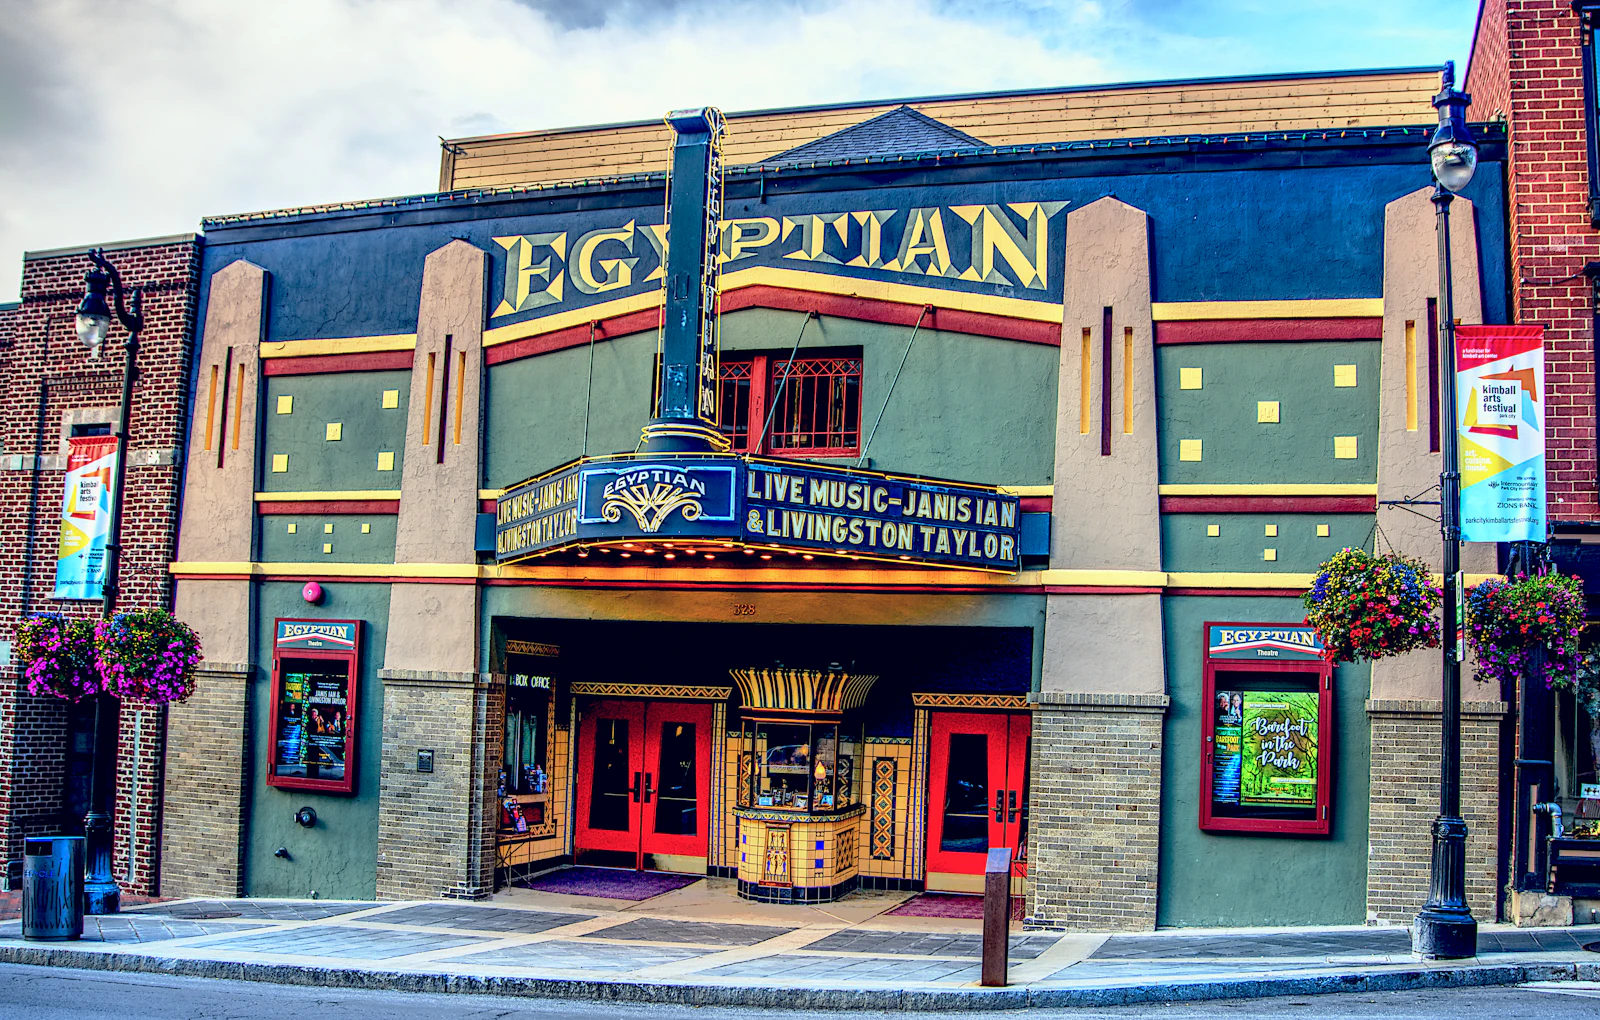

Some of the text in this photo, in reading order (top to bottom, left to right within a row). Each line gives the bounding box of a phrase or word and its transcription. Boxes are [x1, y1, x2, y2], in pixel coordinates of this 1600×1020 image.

[1482, 385, 1516, 394] kimball
[1483, 394, 1501, 403] arts
[1483, 403, 1516, 413] festival
[603, 470, 706, 497] EGYPTIAN
[747, 471, 805, 504] LIVE
[975, 498, 1016, 528] IAN
[542, 507, 577, 543] TAYLOR
[919, 524, 1015, 561] TAYLOR
[733, 603, 756, 616] 328
[284, 623, 349, 639] EGYPTIAN
[1219, 629, 1316, 647] EGYPTIAN
[1256, 649, 1279, 657] Theatre
[515, 673, 550, 689] BOX OFFICE
[1250, 717, 1315, 740] Barefoot
[1261, 735, 1296, 752] in the
[1256, 751, 1300, 769] Park
